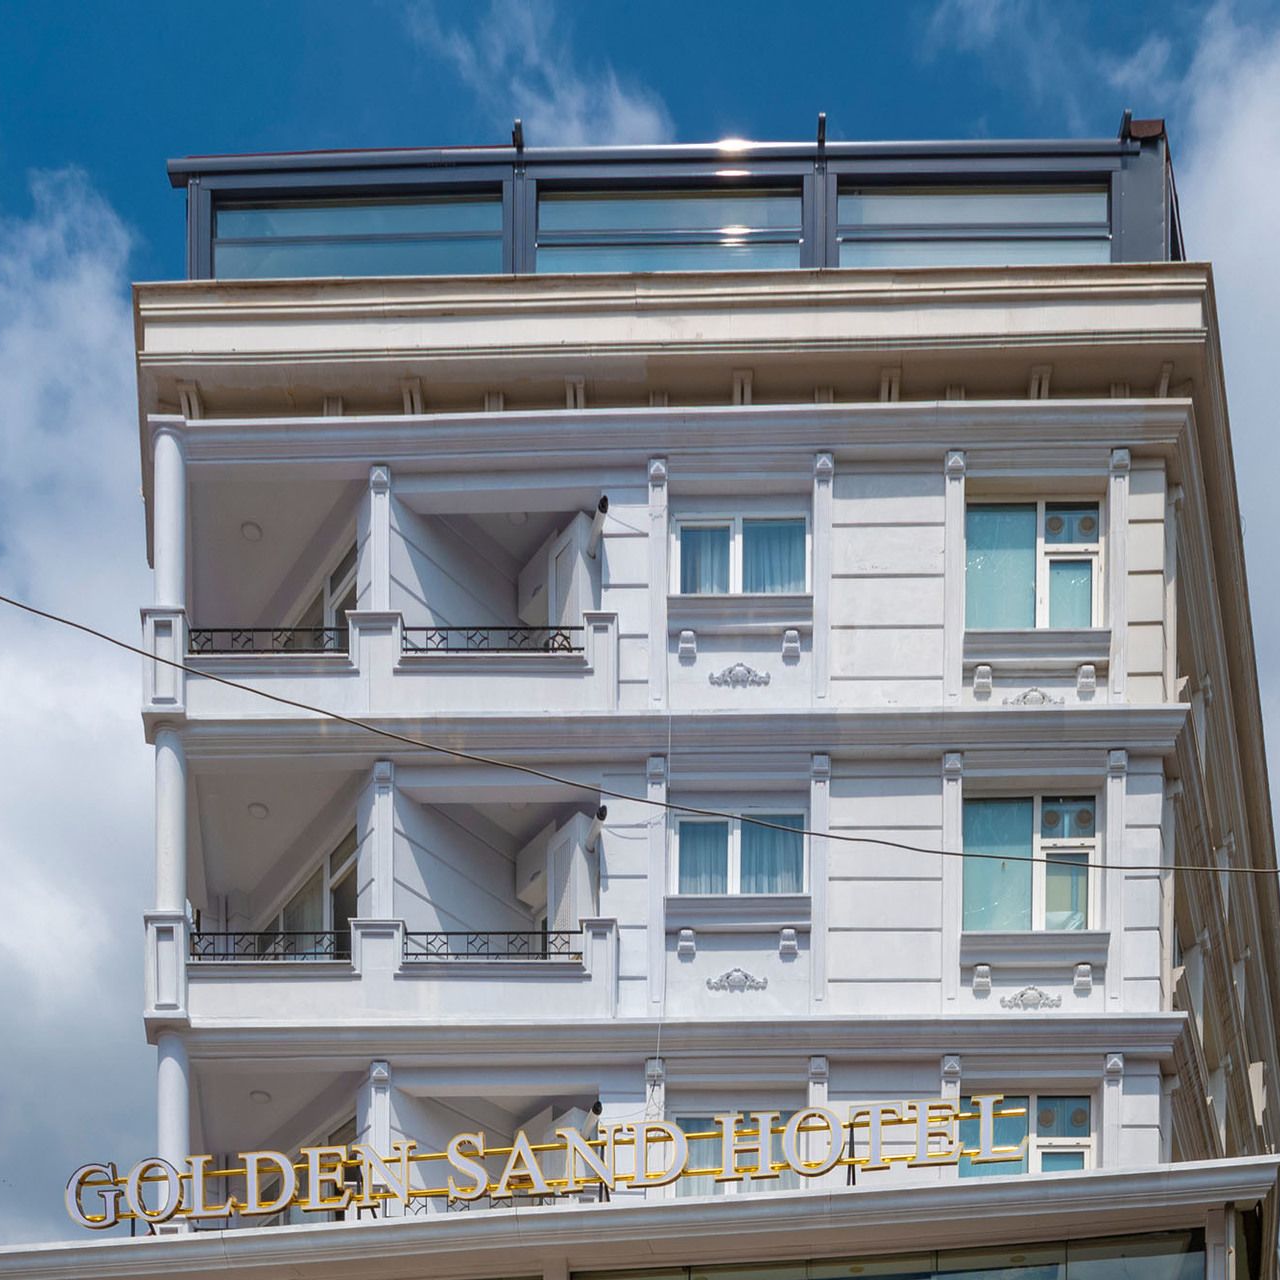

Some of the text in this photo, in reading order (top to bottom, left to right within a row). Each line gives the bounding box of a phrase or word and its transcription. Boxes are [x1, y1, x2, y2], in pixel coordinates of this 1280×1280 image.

[66, 1094, 1028, 1229] GOLDEN SAND HOTEL
